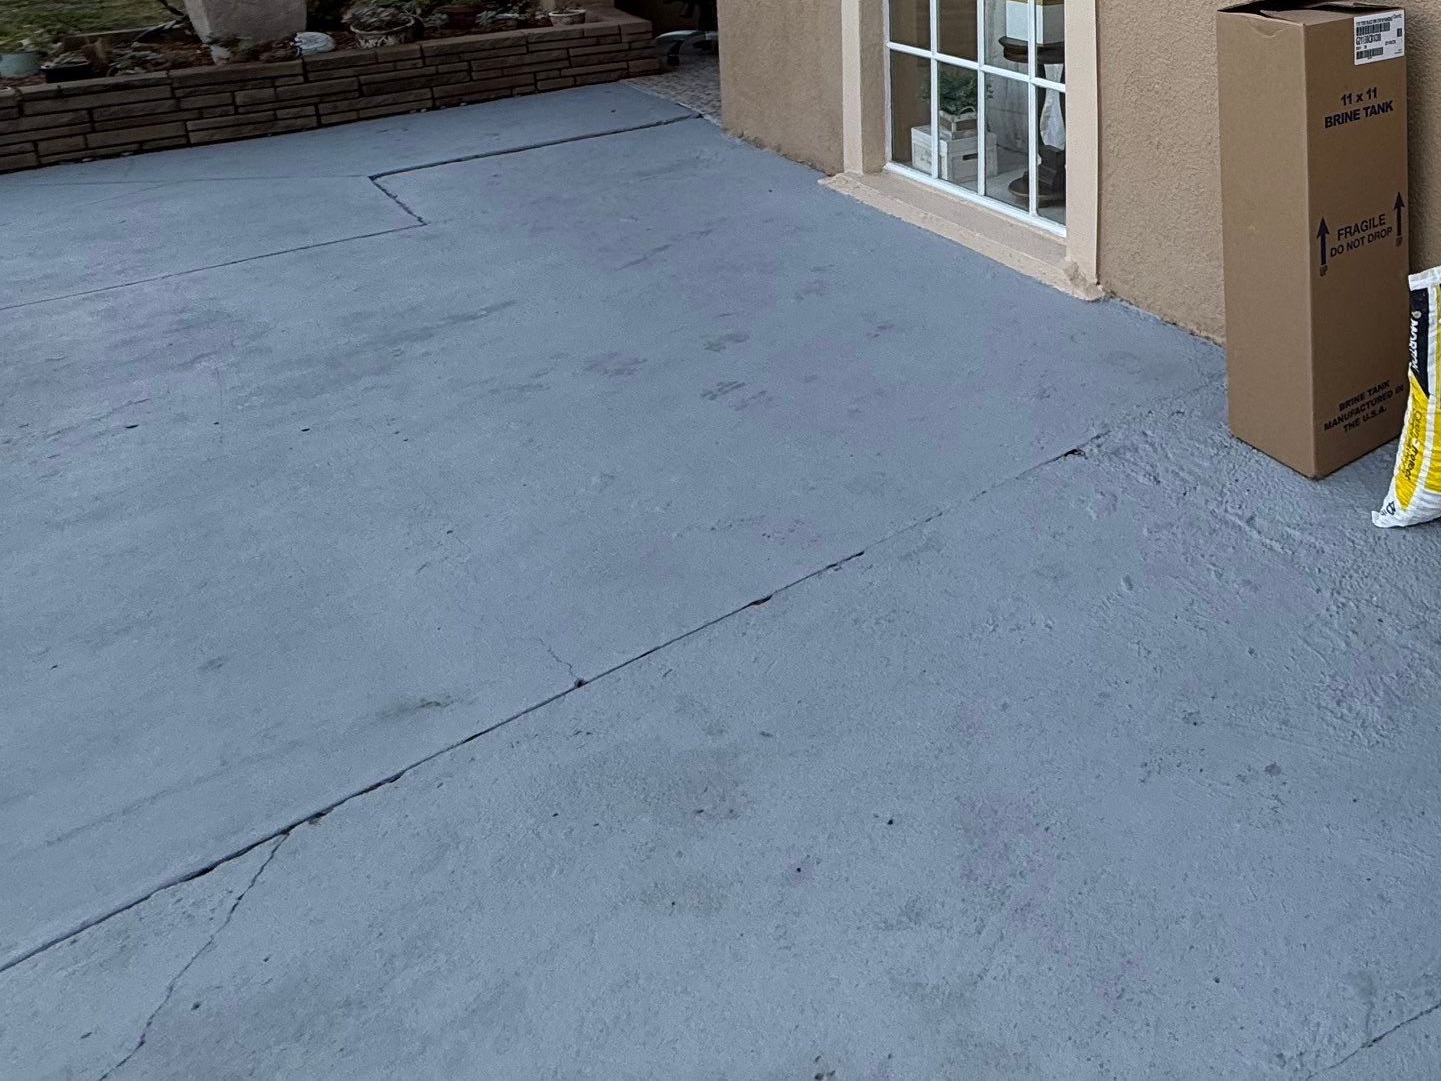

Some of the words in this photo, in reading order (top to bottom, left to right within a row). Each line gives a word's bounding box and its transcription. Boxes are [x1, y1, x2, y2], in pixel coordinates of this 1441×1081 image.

[1340, 92, 1352, 106] 11
[1366, 87, 1377, 99] 11
[1324, 109, 1361, 129] BRINE
[1363, 100, 1394, 118] TANK
[1337, 213, 1386, 241] FRAGILE
[1330, 244, 1344, 258] DO
[1346, 236, 1366, 251] NOT
[1367, 226, 1393, 244] DROP
[1323, 390, 1393, 431] MANUFACTURED
[1338, 392, 1365, 412] BRINE
[1367, 380, 1390, 396] TANK
[1342, 418, 1361, 433] THE
